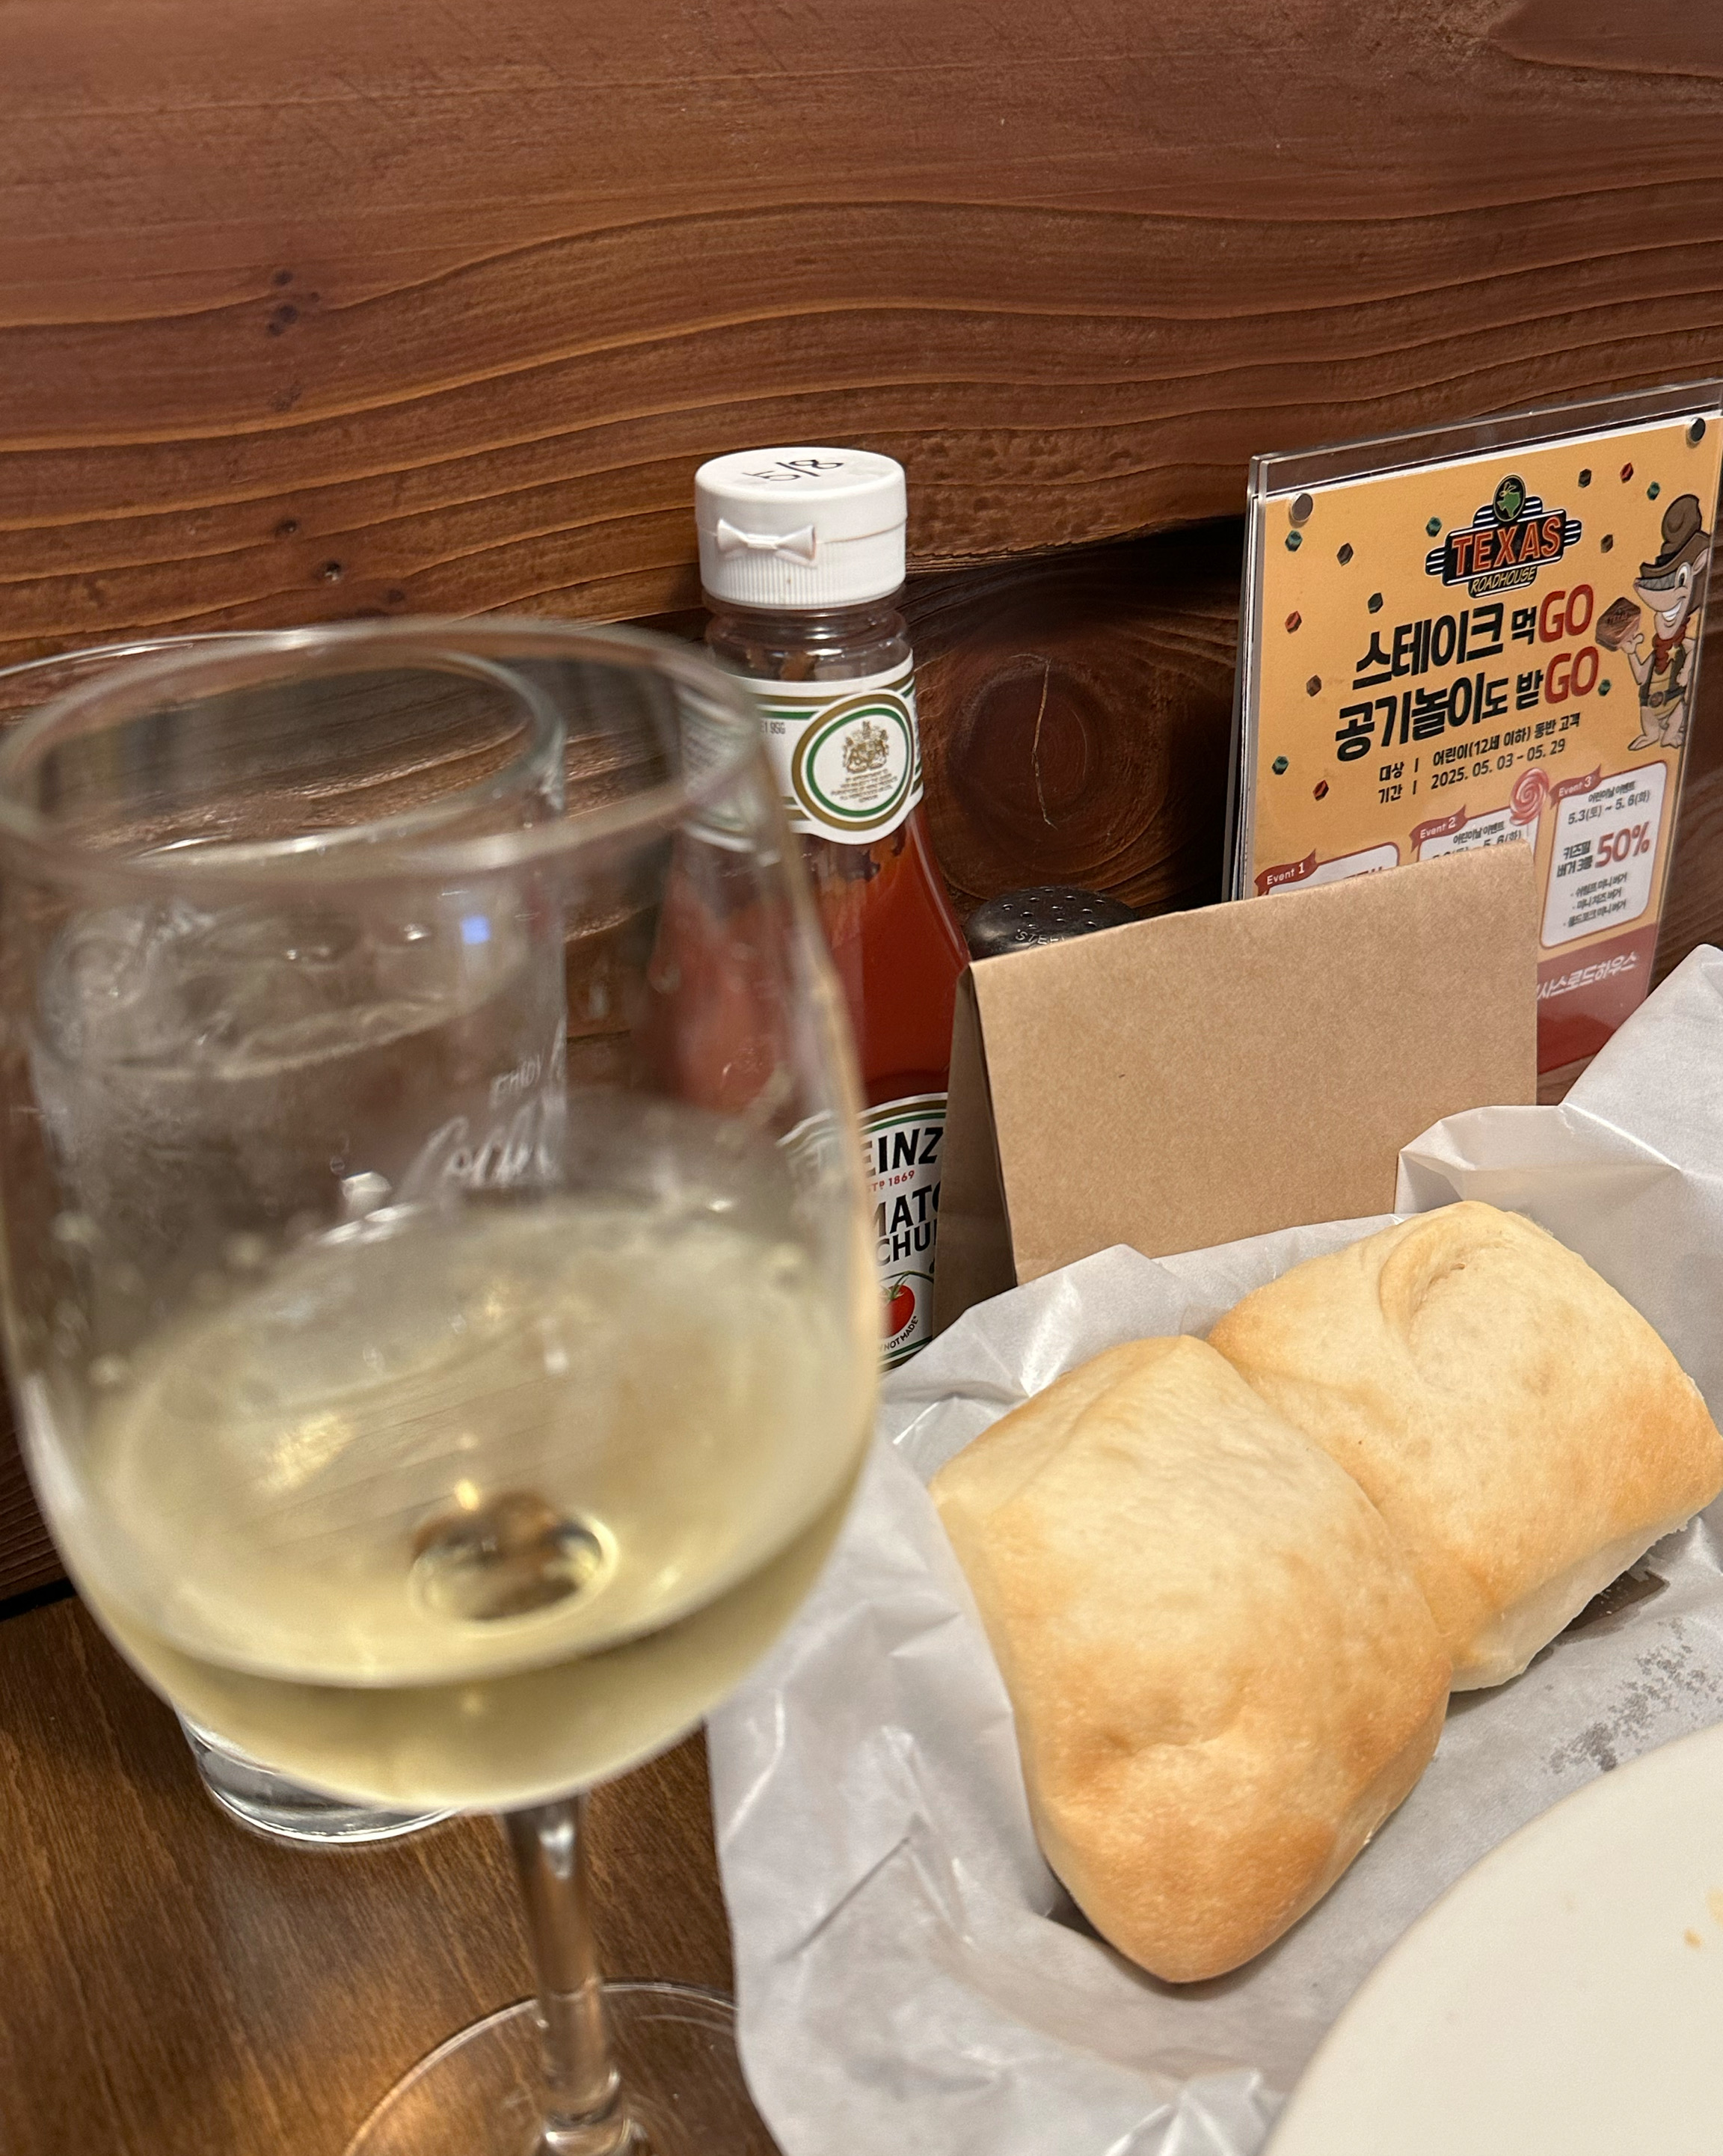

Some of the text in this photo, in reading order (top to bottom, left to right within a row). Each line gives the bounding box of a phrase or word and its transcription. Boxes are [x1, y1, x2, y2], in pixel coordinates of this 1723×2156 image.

[1452, 517, 1563, 576] TEXAS
[1470, 567, 1535, 594] ROADHOUSE
[1352, 602, 1504, 690] 스테이크
[1335, 673, 1509, 762] 공기놀이도
[1378, 784, 1402, 804] 기간
[1550, 738, 1566, 756] 29
[1379, 761, 1404, 782] 대상
[1535, 719, 1556, 738] 동반
[1558, 713, 1580, 731] 고객
[1558, 776, 1591, 797] Event 3
[1420, 817, 1456, 839] Event 2
[1595, 821, 1650, 868] 50%
[1267, 862, 1305, 885] Event 1
[1556, 860, 1576, 877] 버거
[1537, 951, 1638, 1000] 사스로드하우스
[861, 1127, 944, 1177] EINZ
[888, 1170, 915, 1186] 1869
[873, 1181, 941, 1237] MAT
